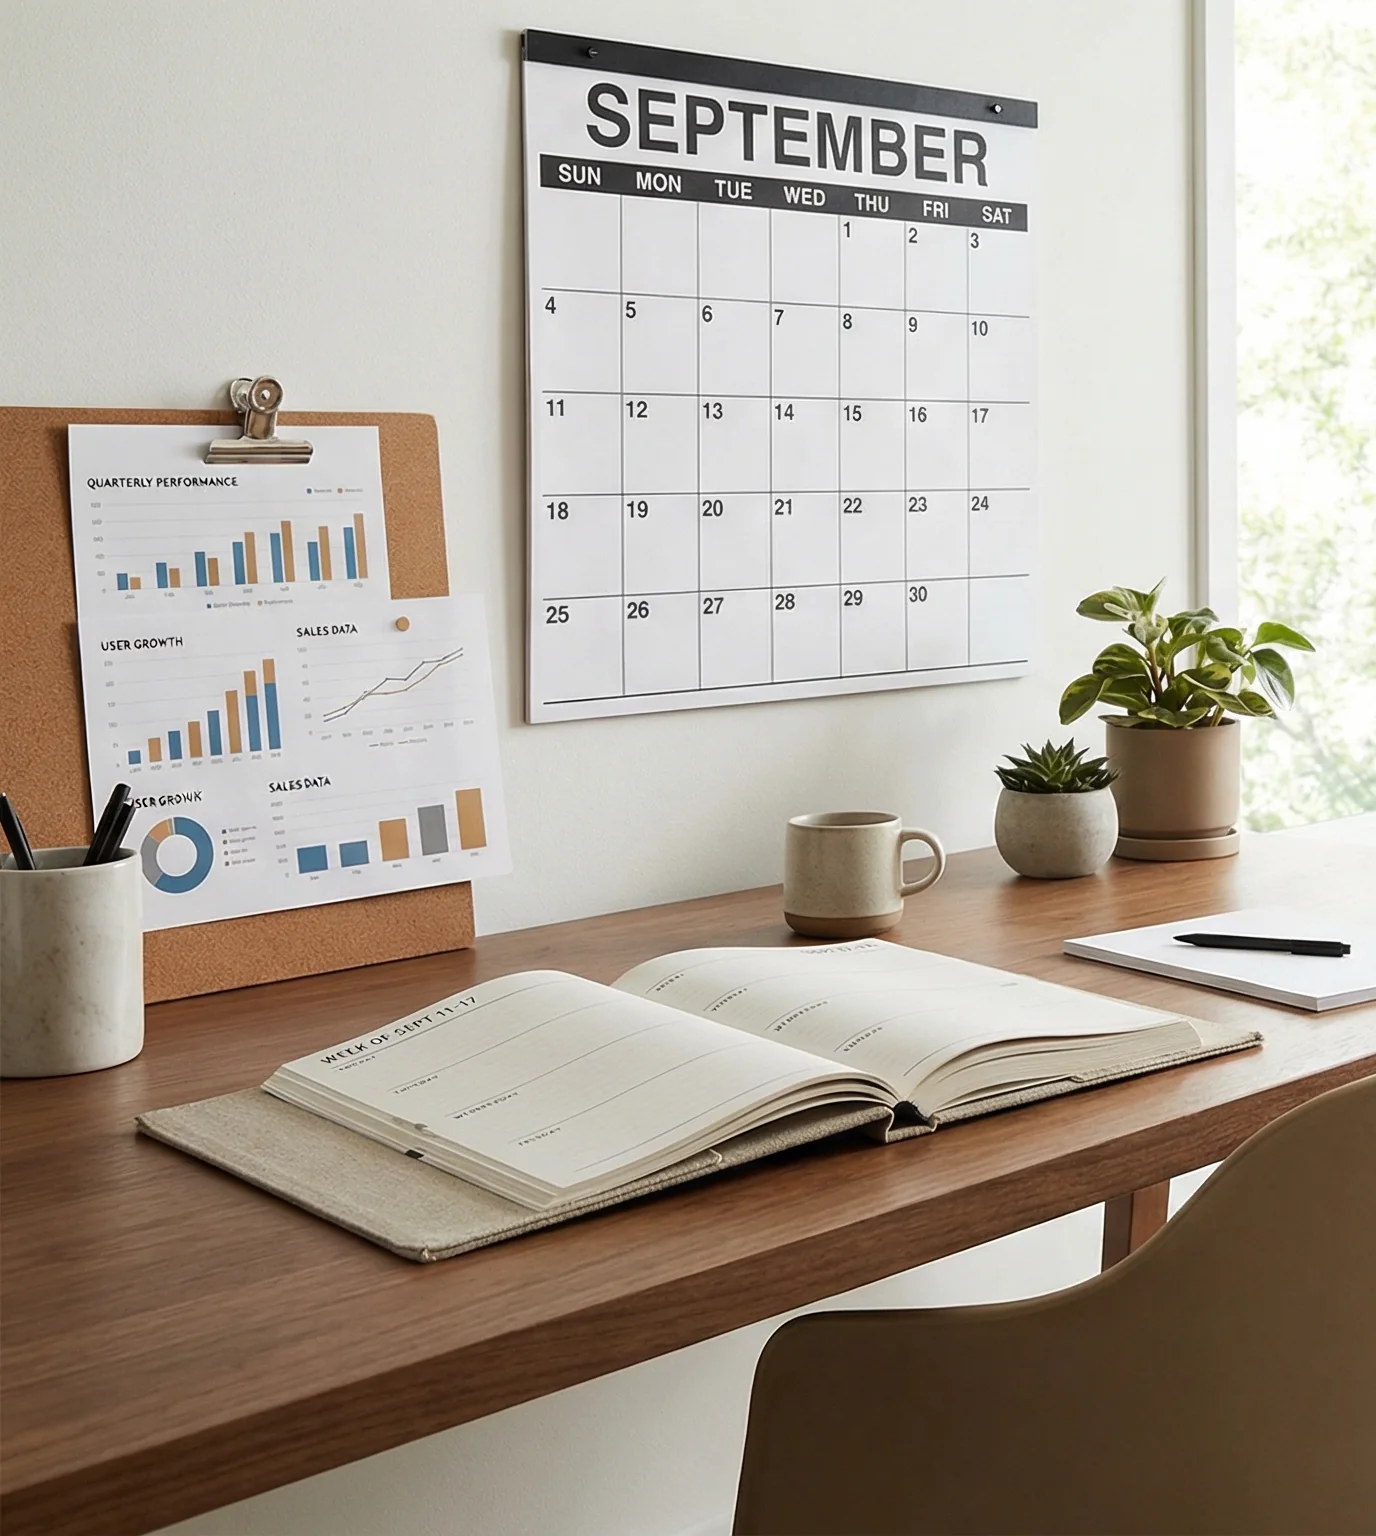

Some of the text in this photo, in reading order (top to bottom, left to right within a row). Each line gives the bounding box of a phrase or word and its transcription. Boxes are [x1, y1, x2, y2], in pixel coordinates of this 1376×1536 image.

[586, 82, 989, 187] SEPTEMBER
[559, 164, 1012, 224] SUN MON TUE WED THU FRI SAT
[844, 222, 979, 249] 1 2 3
[545, 297, 987, 336] 4 5 6 7 8 9 10
[547, 400, 988, 424] 11 12 13 14 15 16 17
[87, 477, 238, 490] QUARTERLY PERFORMANCE
[547, 496, 989, 519] 18 19 20 21 22 23 24
[546, 586, 928, 624] 25 26 27 28 29 30
[297, 624, 357, 637] SALES DATA
[101, 637, 183, 651] USER GROWTH
[269, 777, 331, 793] SALES DATA
[436, 996, 476, 1017] 11-17
